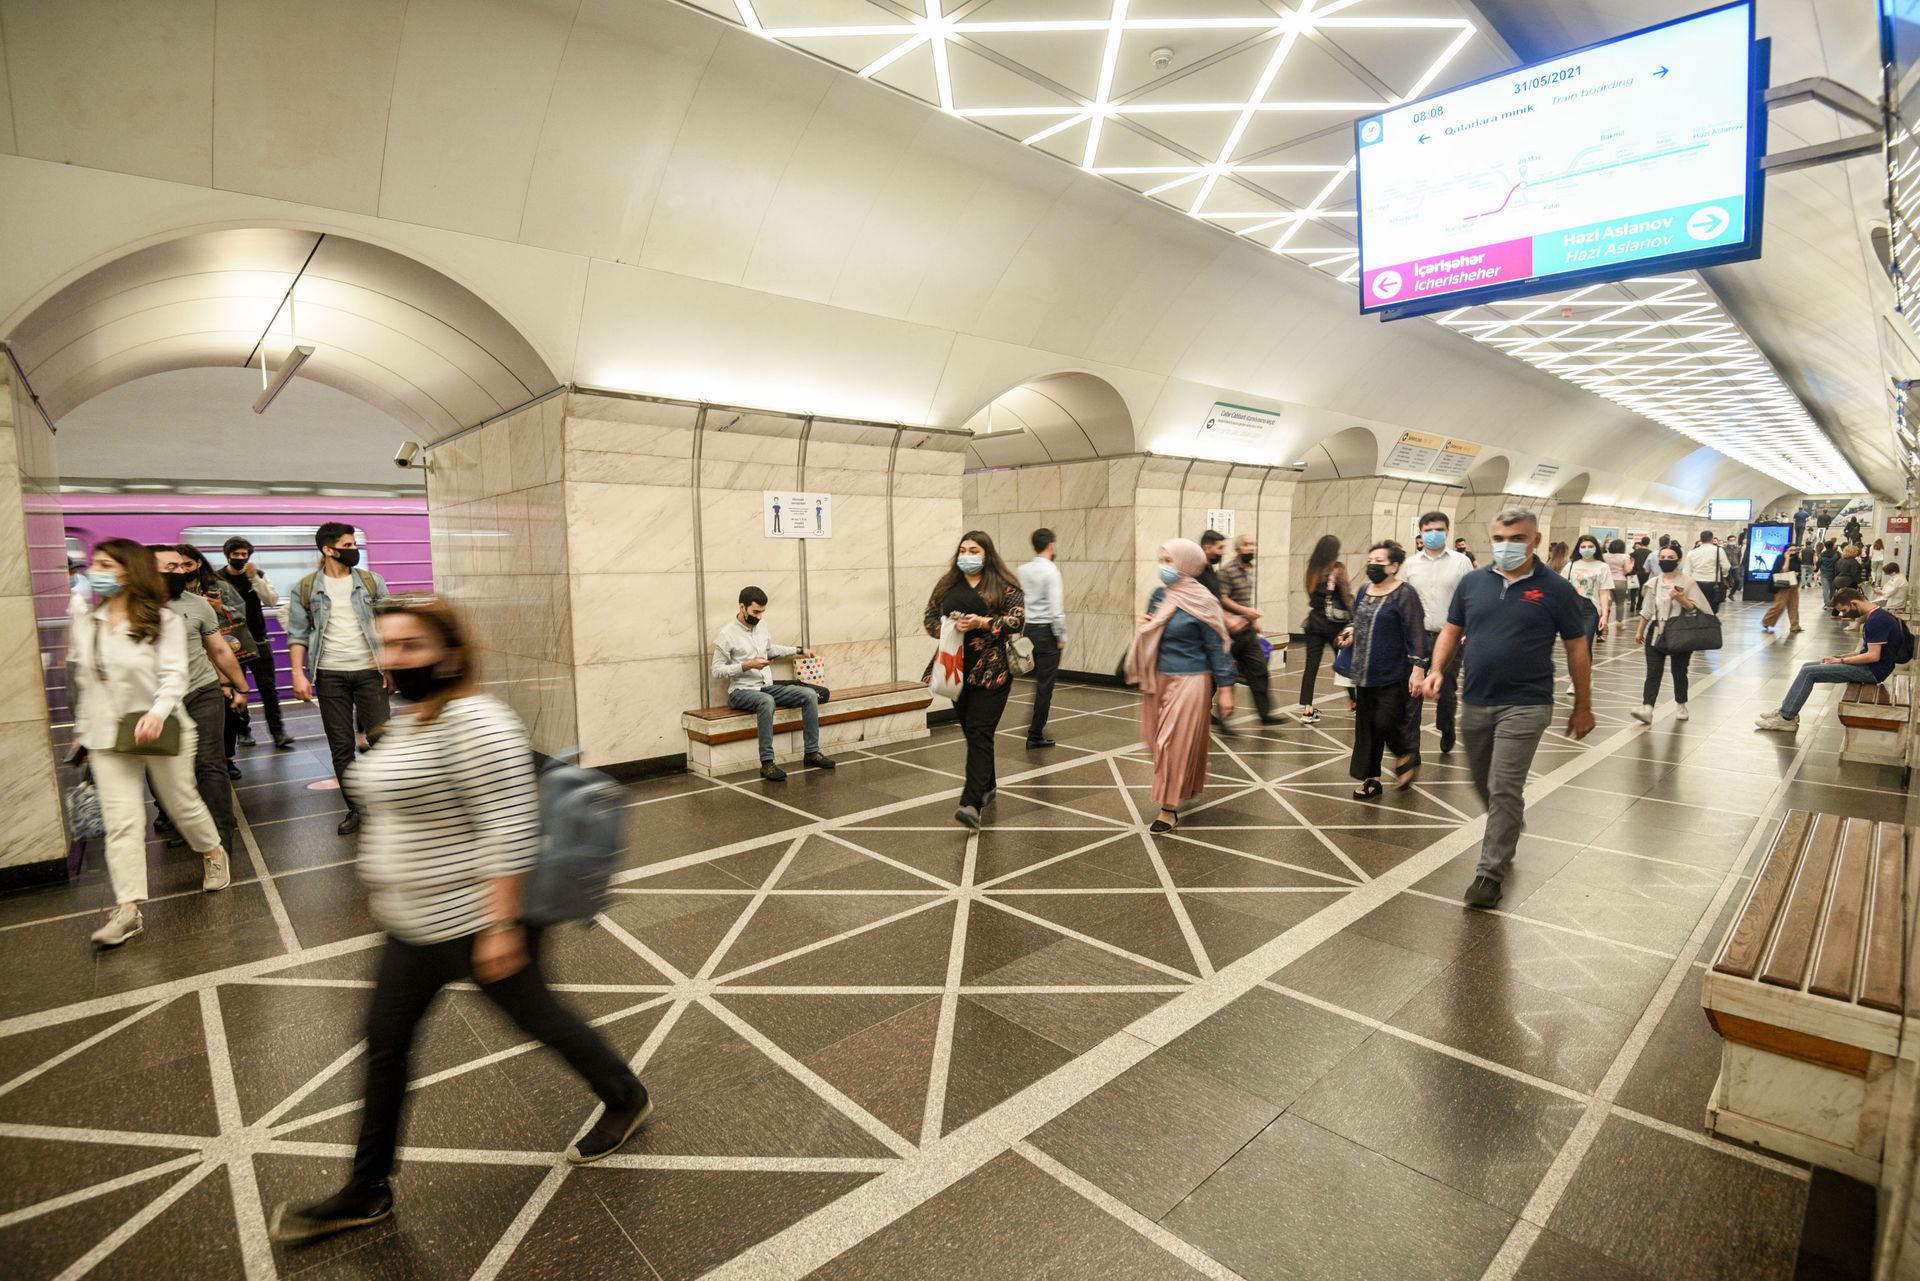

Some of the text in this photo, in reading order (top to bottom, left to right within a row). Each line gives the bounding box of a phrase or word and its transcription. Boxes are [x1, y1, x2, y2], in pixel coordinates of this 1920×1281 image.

[1514, 66, 1581, 94] 31/05/2021
[1552, 77, 1634, 105] Train boarding
[1413, 105, 1445, 124] 08:08
[1445, 104, 1534, 135] Qatarlara minik
[1563, 215, 1675, 247] Həzi Aslanov
[1565, 232, 1674, 264] Hazi Aslanov
[1414, 251, 1486, 278] İçərişəhər
[1414, 264, 1501, 292] Icherisheher
